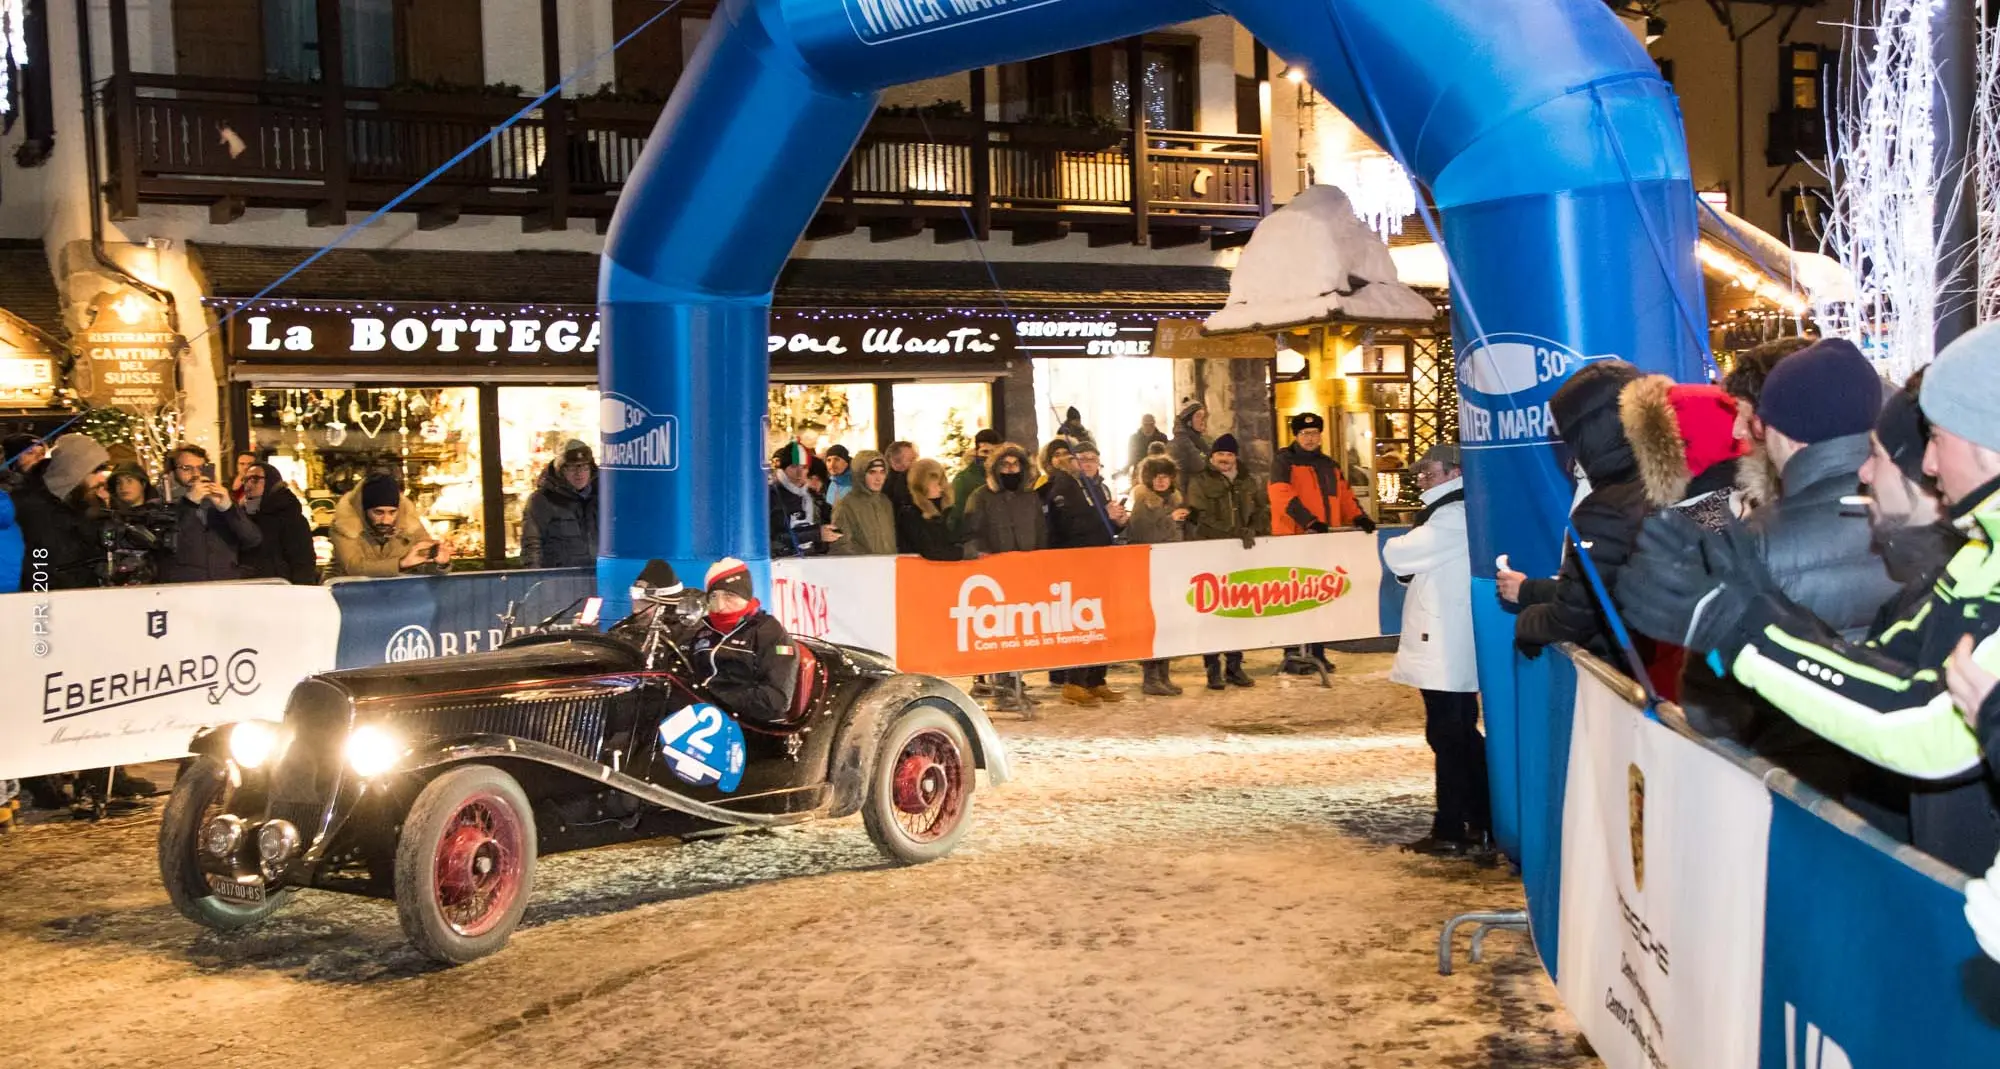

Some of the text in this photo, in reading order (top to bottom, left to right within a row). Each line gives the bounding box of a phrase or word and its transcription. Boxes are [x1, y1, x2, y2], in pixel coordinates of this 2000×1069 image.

[246, 316, 314, 351] La
[1015, 321, 1118, 337] SHOPPING
[89, 348, 174, 360] CANTINA
[1086, 340, 1151, 356] STORE
[118, 361, 148, 372] DEL
[103, 372, 163, 385] SUISSE
[1497, 400, 1561, 440] MARA
[949, 574, 1106, 652] famila
[974, 639, 998, 651] Con
[1002, 637, 1020, 650] noi
[1024, 636, 1040, 648] sei
[1042, 634, 1054, 646] in
[43, 654, 219, 716] EBERHARD
